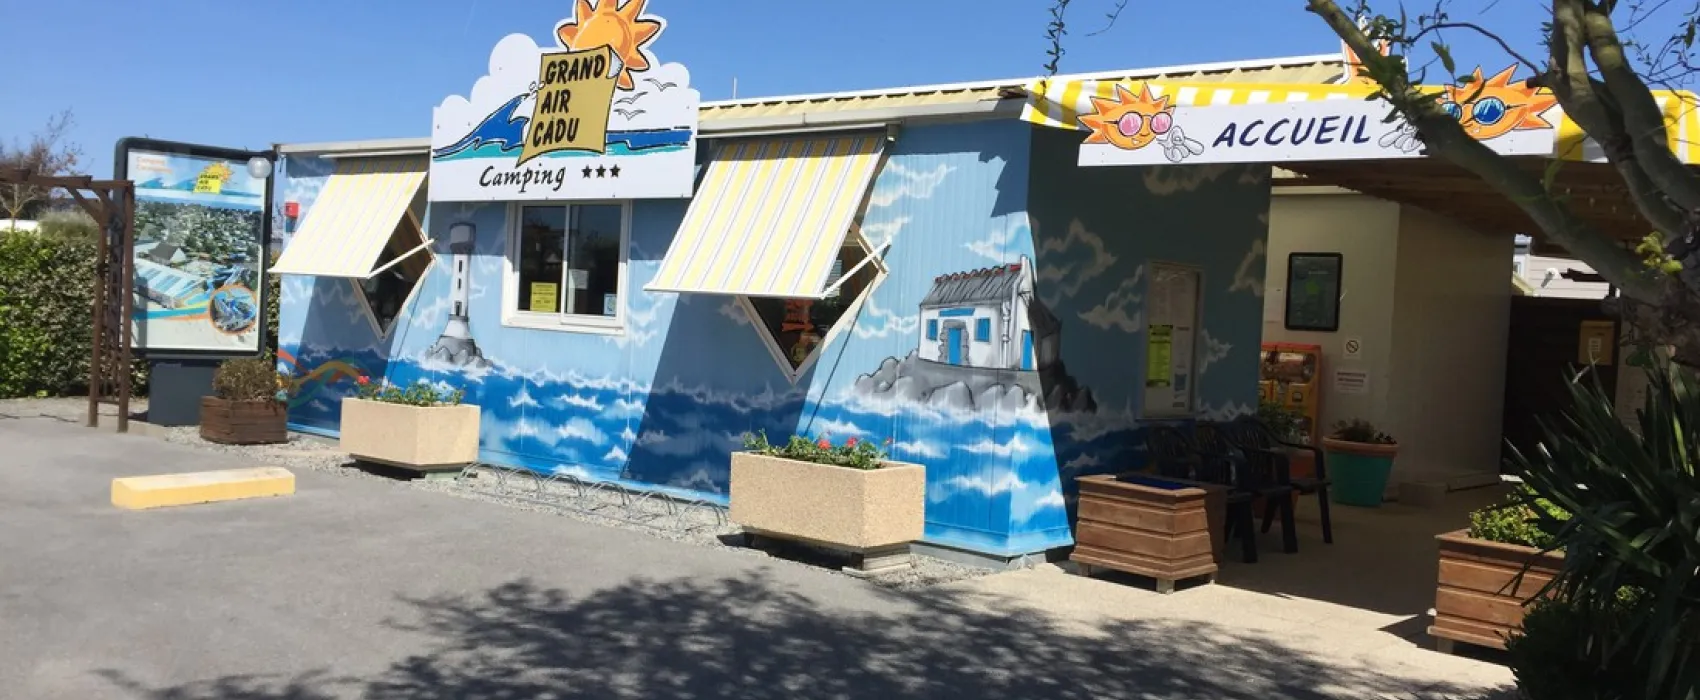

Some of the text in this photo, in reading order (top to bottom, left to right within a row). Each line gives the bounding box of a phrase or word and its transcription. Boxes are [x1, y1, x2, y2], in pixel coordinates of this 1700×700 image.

[545, 55, 606, 84] GRAND
[540, 89, 570, 114] AIR
[532, 118, 579, 148] CADU
[1212, 115, 1371, 149] ACCUEIL
[479, 163, 566, 193] Camping
